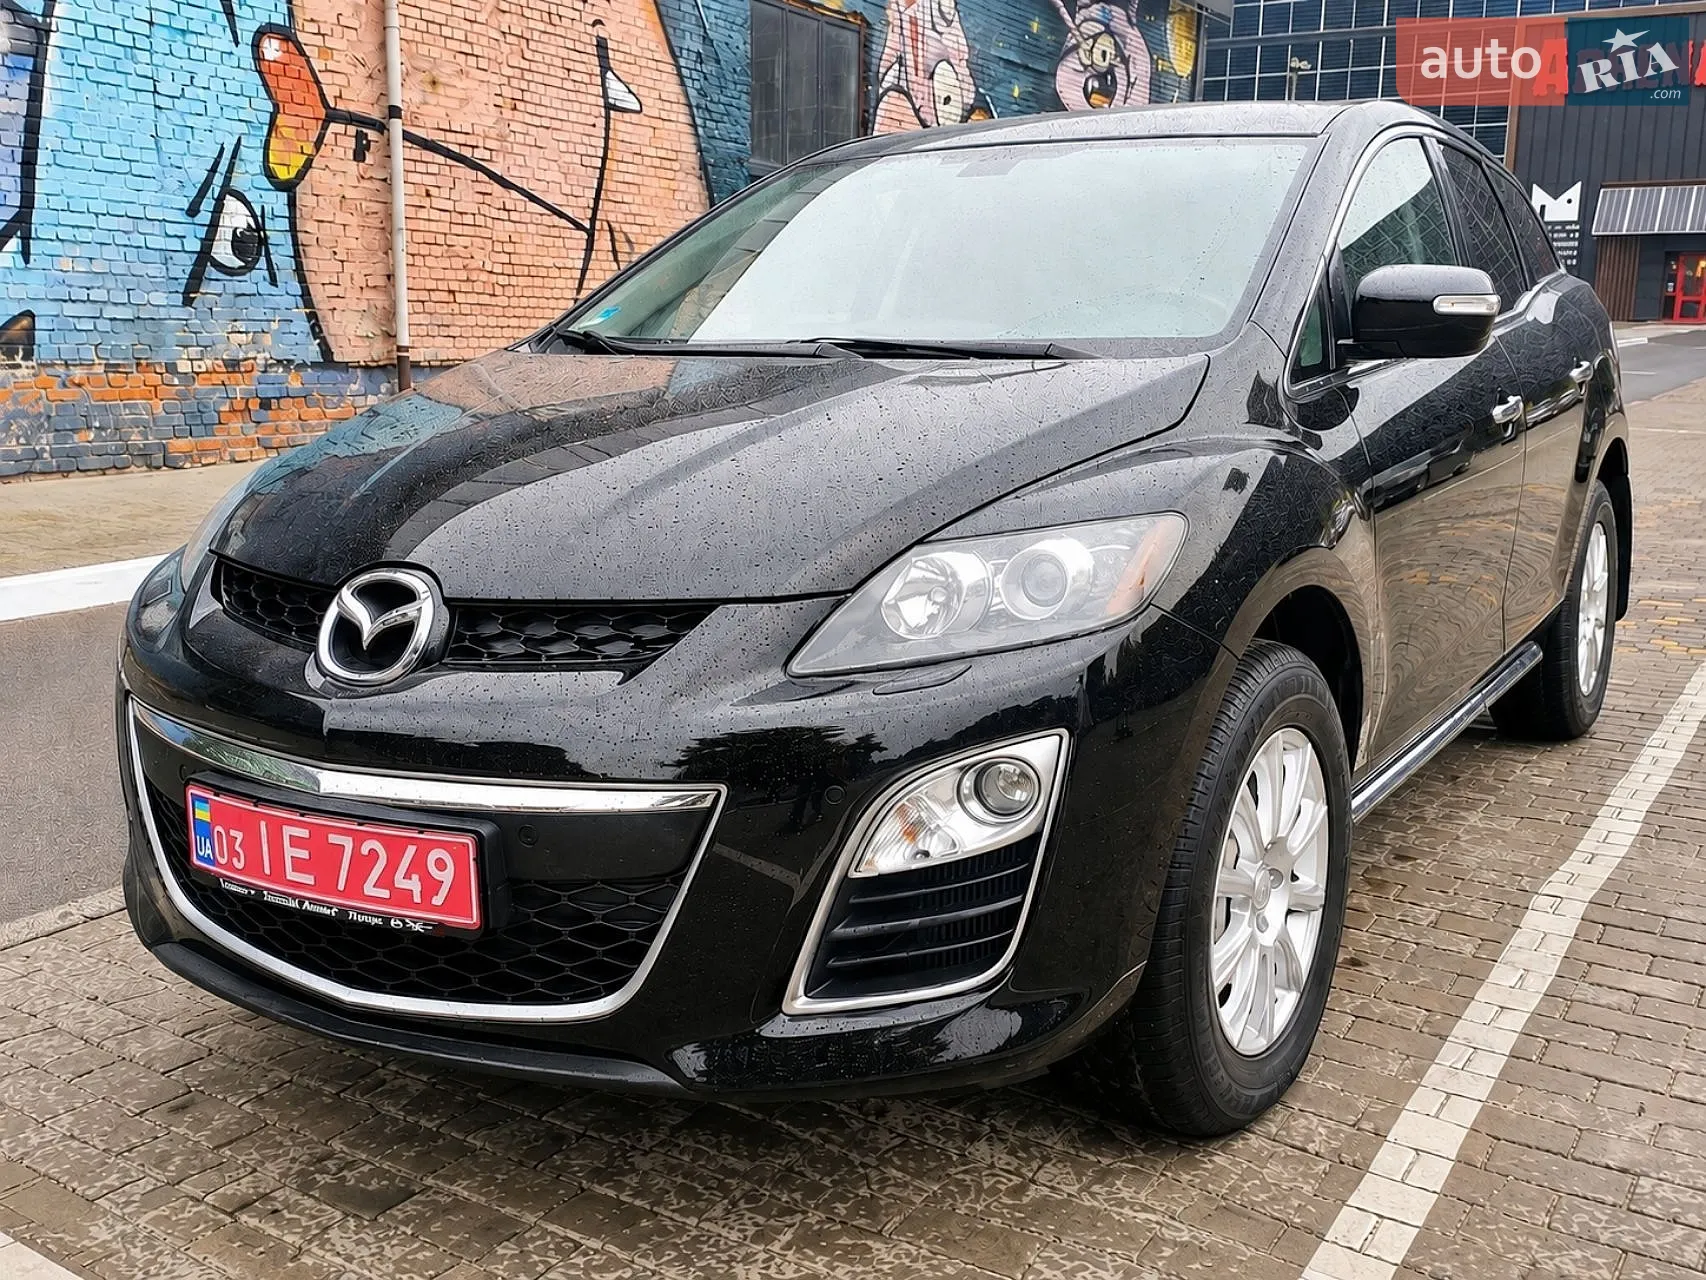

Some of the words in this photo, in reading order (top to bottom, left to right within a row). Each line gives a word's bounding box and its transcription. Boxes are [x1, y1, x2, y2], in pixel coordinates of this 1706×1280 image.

[196, 834, 214, 861] UA
[213, 824, 246, 871] 03
[259, 819, 316, 886] IE
[327, 832, 456, 907] 7249
